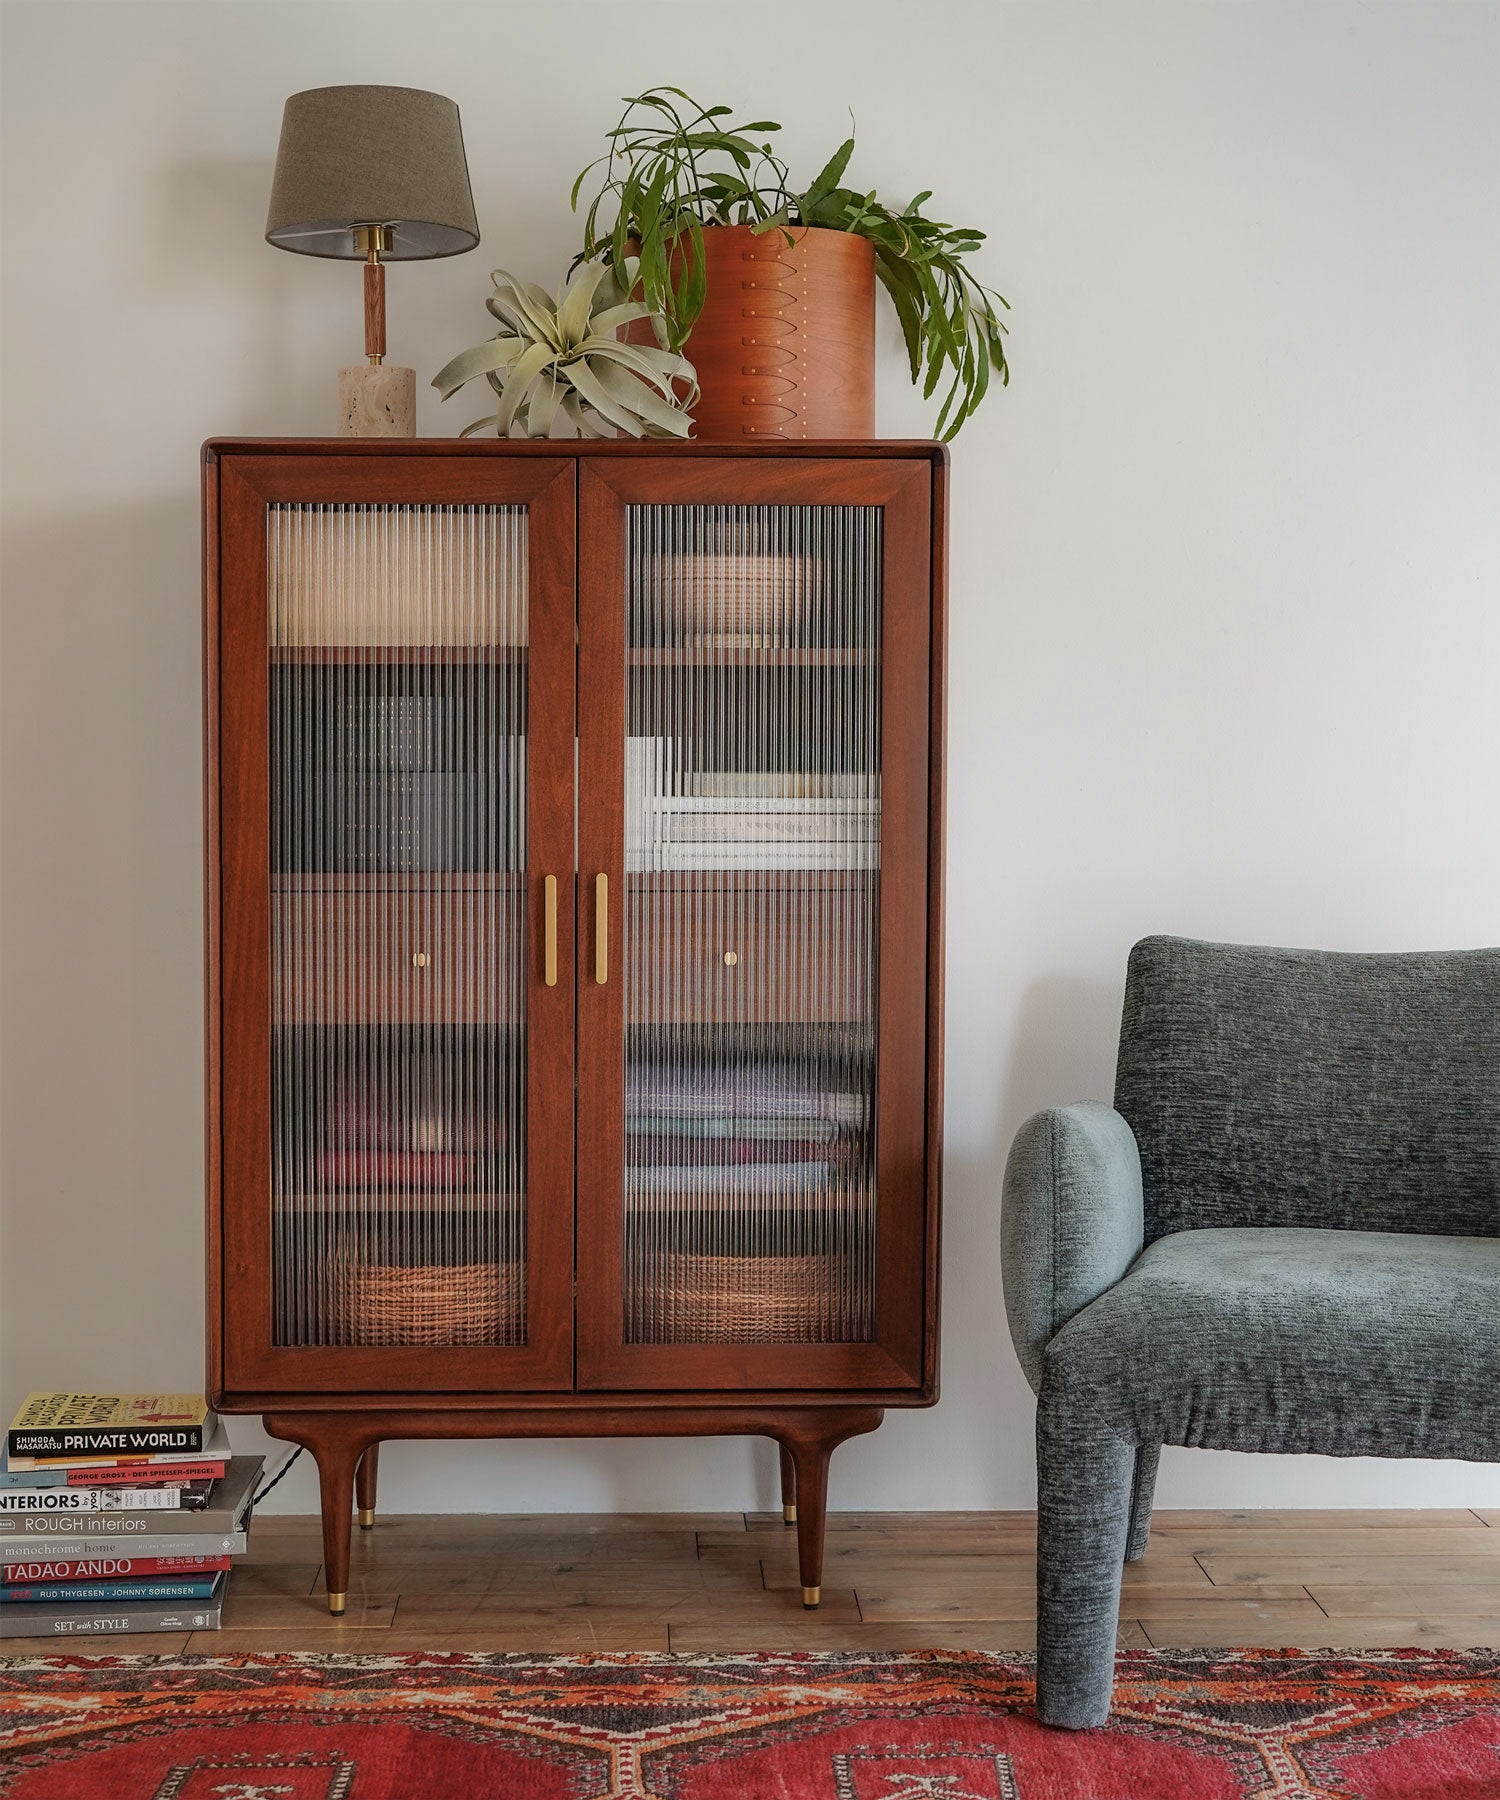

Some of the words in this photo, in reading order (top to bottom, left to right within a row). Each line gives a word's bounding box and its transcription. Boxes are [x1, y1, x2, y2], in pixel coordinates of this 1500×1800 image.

[57, 1394, 96, 1425] PRIVATE
[83, 1397, 120, 1425] WORLD
[16, 1442, 62, 1450] MASAKATSU
[64, 1434, 127, 1449] PRIVATE
[130, 1433, 187, 1447] WORLD
[150, 1467, 215, 1477] SPIESSER-SPIEGEL
[0, 1495, 80, 1509] NTERIORS
[90, 1491, 98, 1510] yoo
[25, 1517, 83, 1531] ROUGH
[88, 1517, 147, 1531] interiors
[5, 1543, 81, 1556] monochrome
[84, 1542, 116, 1553] home
[4, 1562, 70, 1580] TADAO
[75, 1559, 132, 1577] ANDO
[40, 1590, 58, 1598] RUD
[60, 1589, 104, 1598] THYGESEN
[112, 1589, 146, 1597] JOHNNY
[148, 1587, 194, 1595] SØRENSEN
[54, 1621, 75, 1632] SET
[76, 1621, 92, 1630] with
[93, 1618, 129, 1630] STYLE
